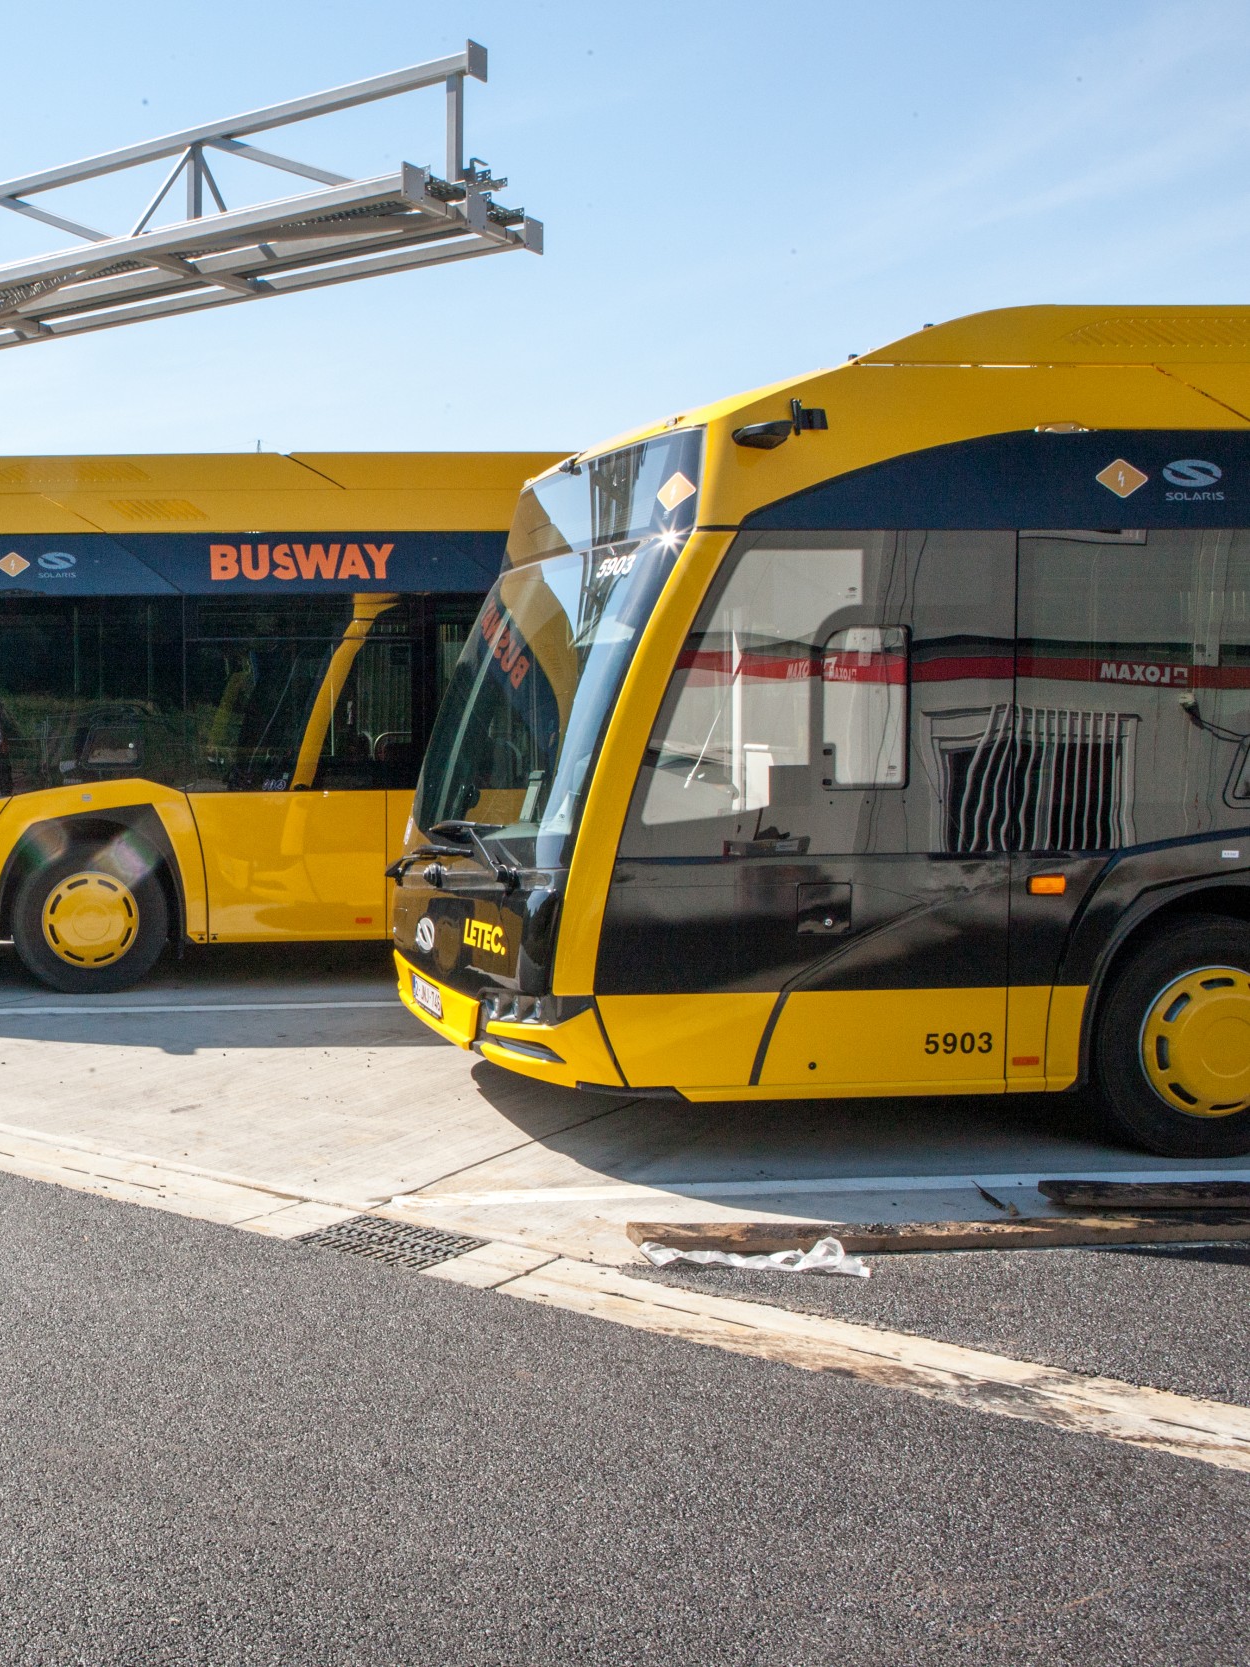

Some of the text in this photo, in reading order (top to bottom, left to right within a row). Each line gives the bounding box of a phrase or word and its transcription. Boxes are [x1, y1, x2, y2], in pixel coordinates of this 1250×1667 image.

[1165, 492, 1225, 501] SOLARIS
[209, 543, 395, 581] BUSWAY
[596, 554, 637, 579] 5903
[463, 917, 507, 956] LETEC.
[924, 1031, 993, 1055] 5903
